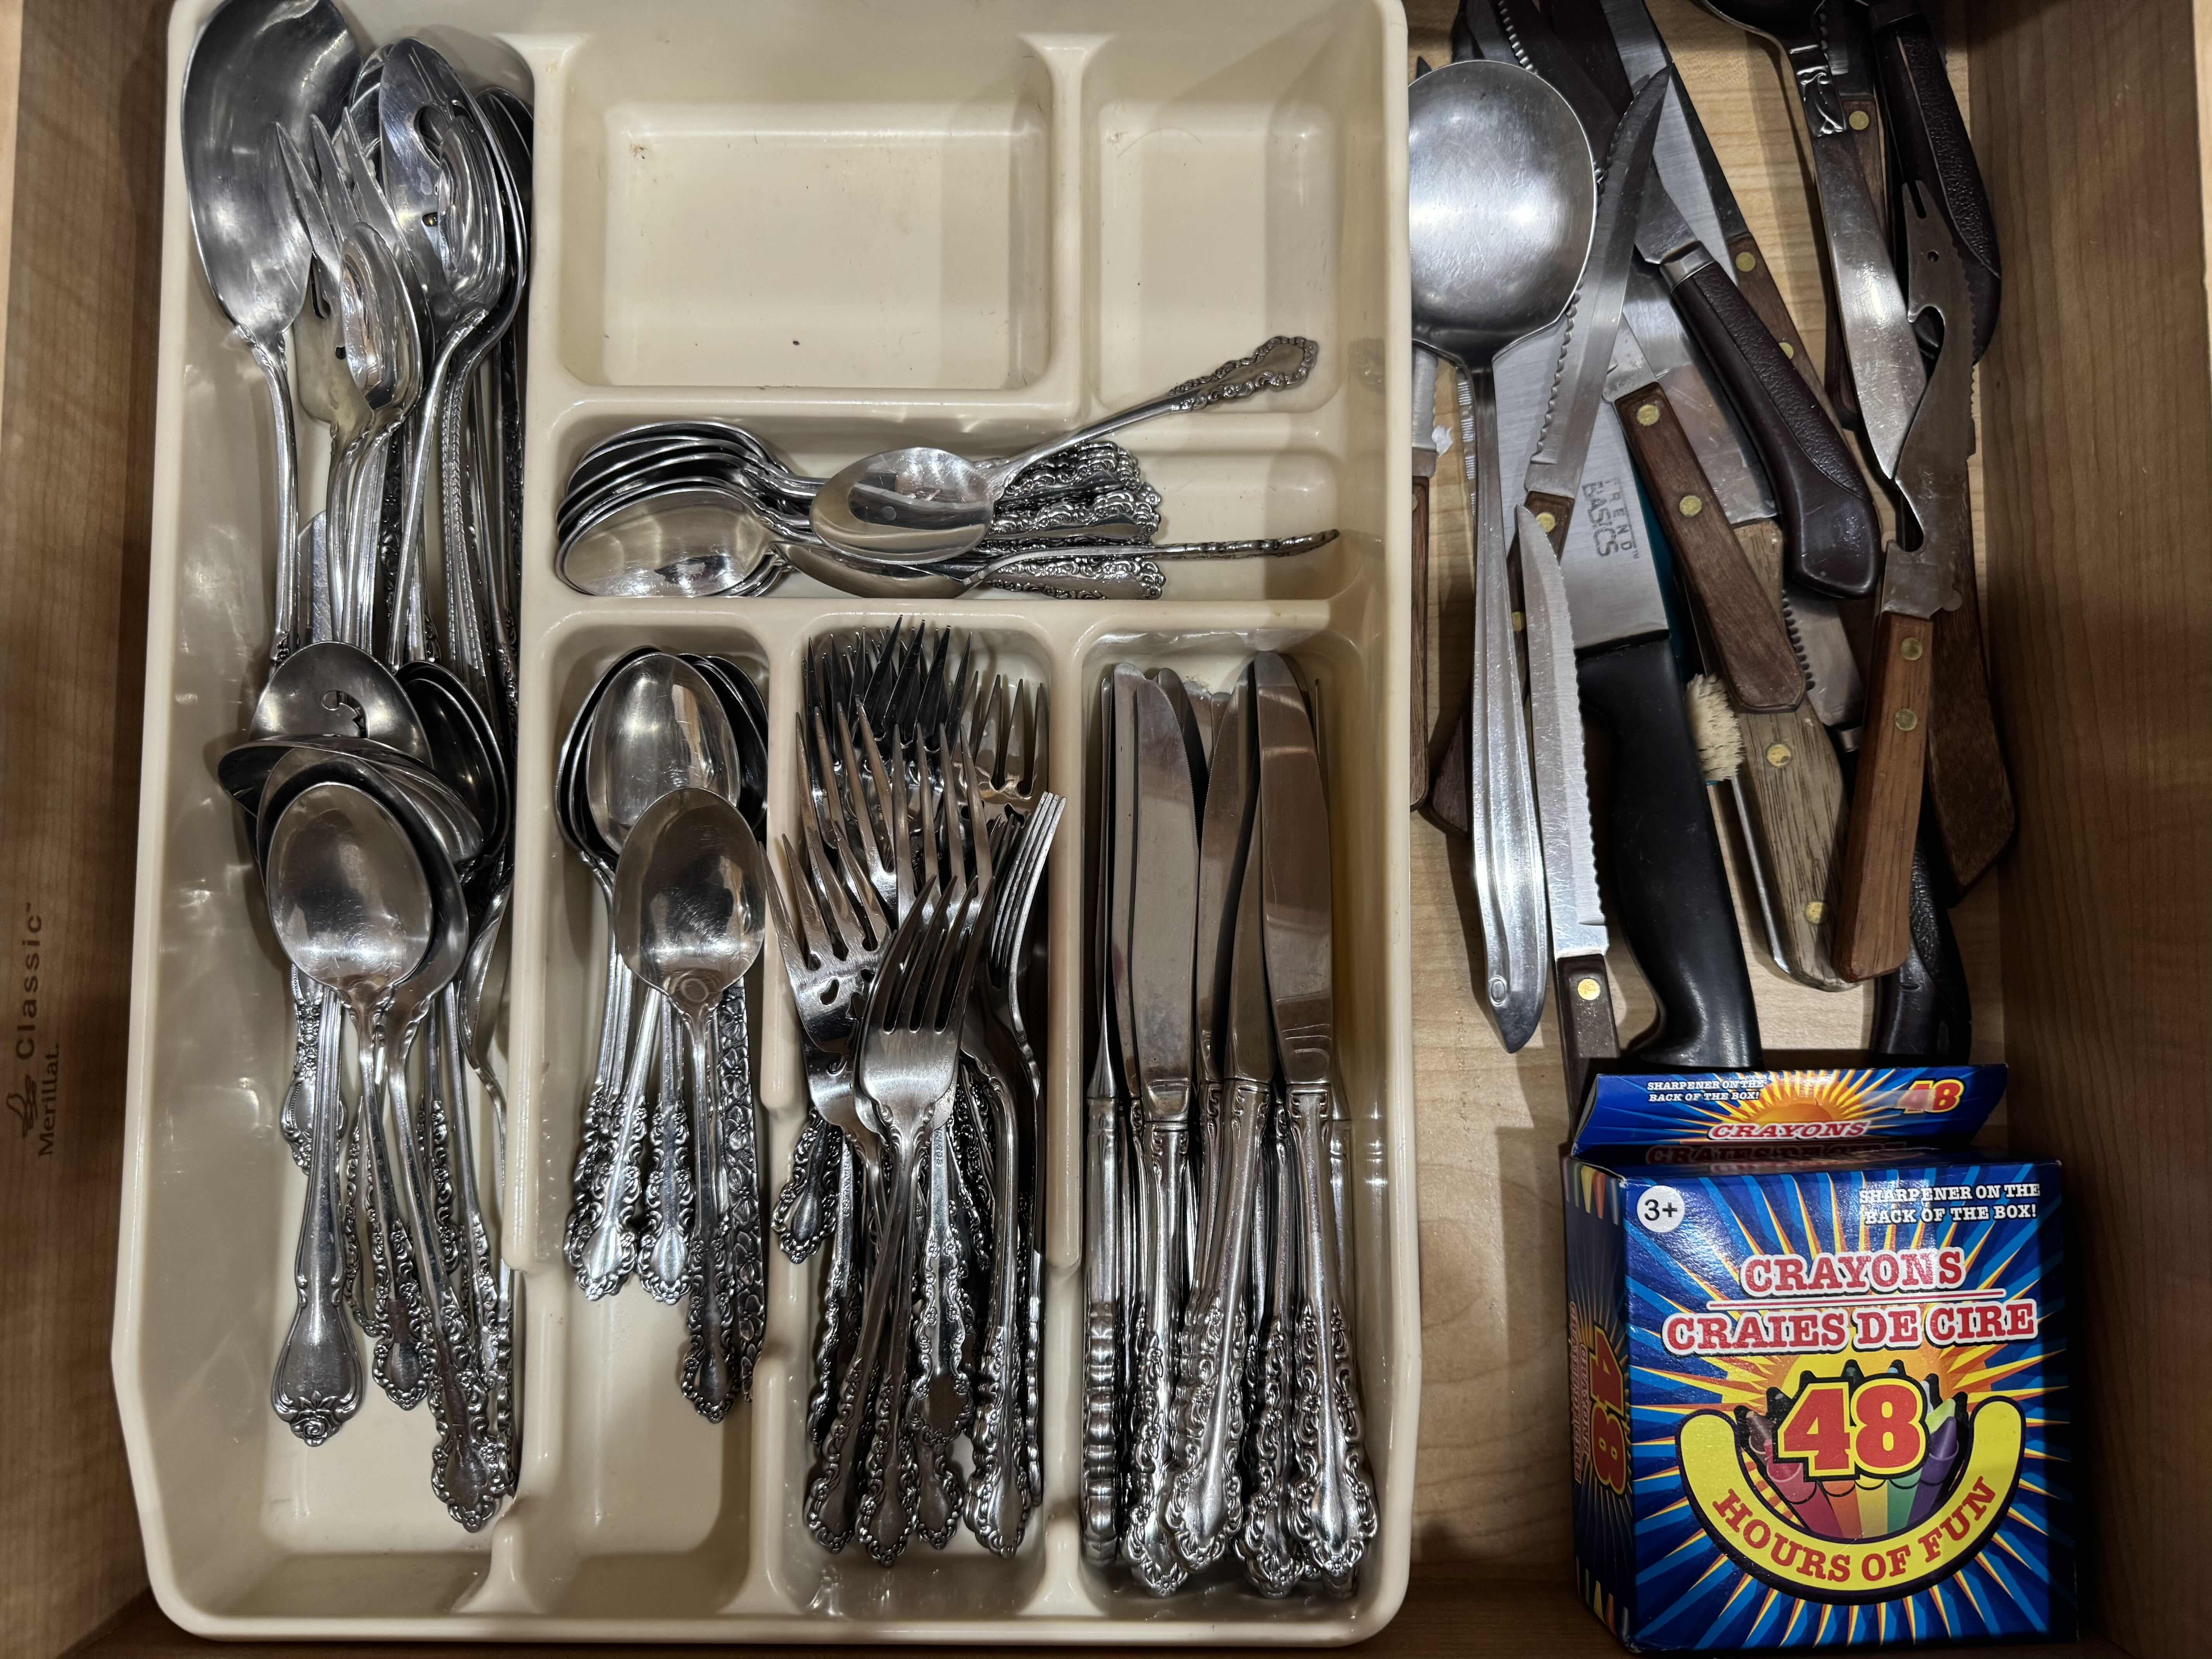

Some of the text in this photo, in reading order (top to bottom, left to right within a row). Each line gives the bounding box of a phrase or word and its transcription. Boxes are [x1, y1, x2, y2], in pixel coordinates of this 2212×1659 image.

[1582, 481, 1619, 556] BASICS
[1647, 1079, 1765, 1091] SHARPENER ON THE
[1648, 1091, 1760, 1102] BACK OF THE BOX!
[1898, 1079, 1964, 1114] 48
[1709, 1121, 1869, 1139] CRAYONS
[1644, 1199, 1678, 1221] 3+
[1859, 1183, 2040, 1203] SHARPENER ON THE
[1865, 1204, 2036, 1224] BACK OF THE BOX!
[1743, 1249, 1965, 1295] CRAYONS
[1664, 1300, 2036, 1352] CRAIES DE CIRE
[1589, 1326, 1626, 1495] 48
[1777, 1377, 1927, 1477] 48
[1712, 1476, 1996, 1582] HOURS OF FUN
